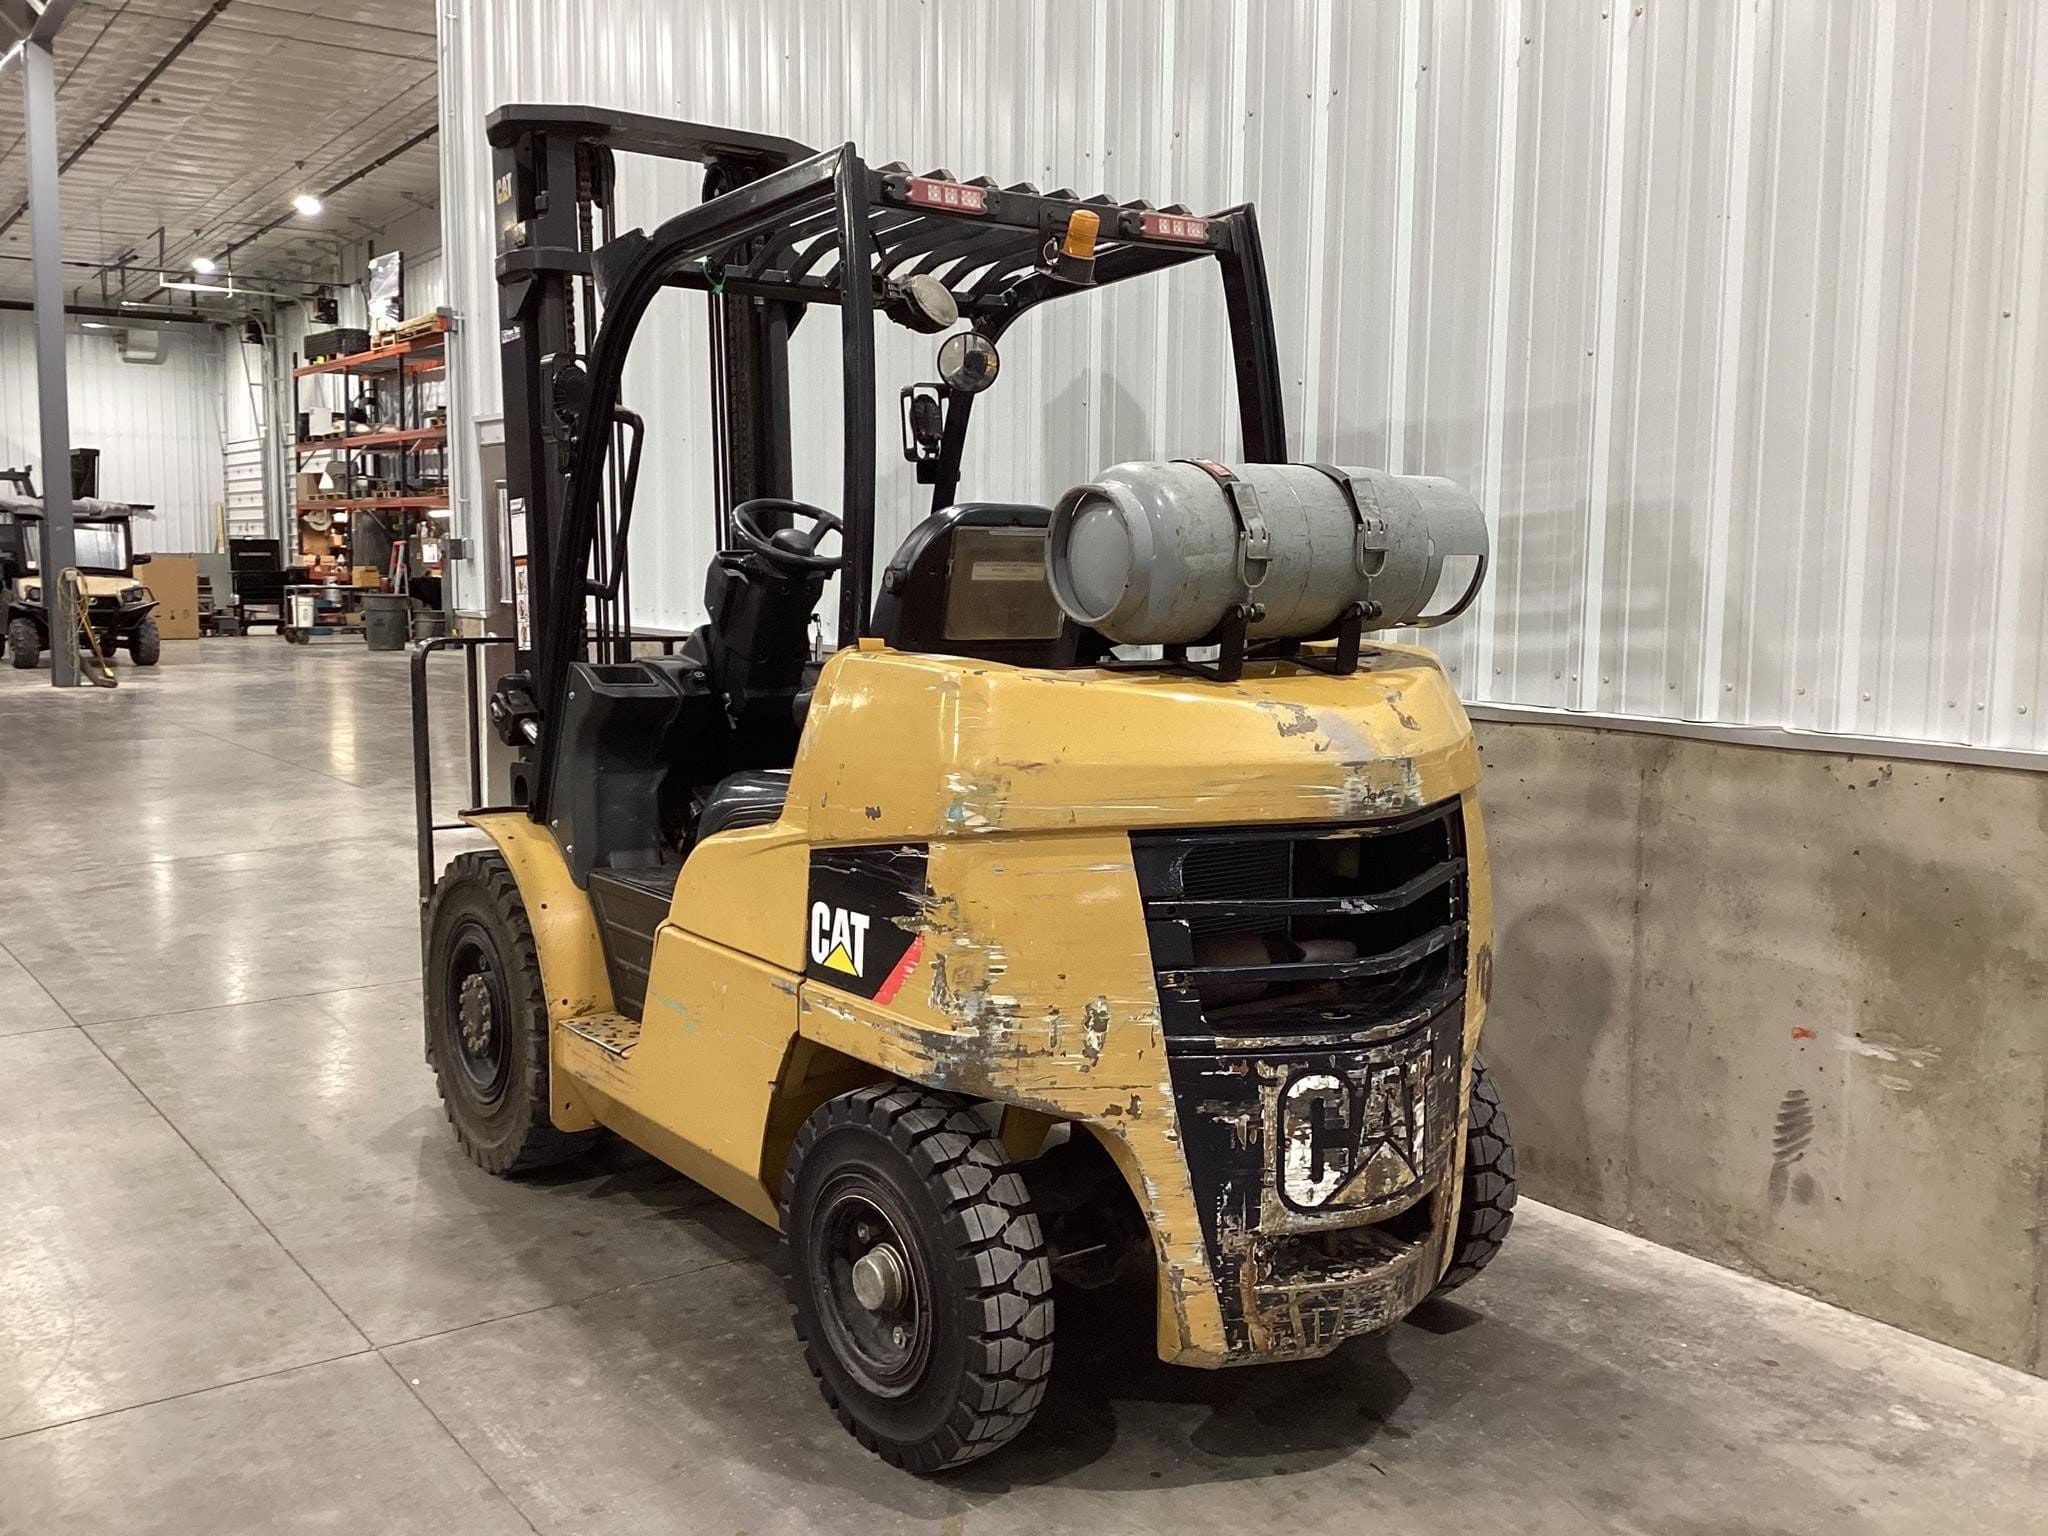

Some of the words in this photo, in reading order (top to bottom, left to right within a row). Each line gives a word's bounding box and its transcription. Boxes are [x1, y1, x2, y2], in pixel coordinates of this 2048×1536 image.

[496, 171, 513, 205] CAT
[811, 901, 870, 978] CAT
[1283, 1048, 1433, 1208] CAT
